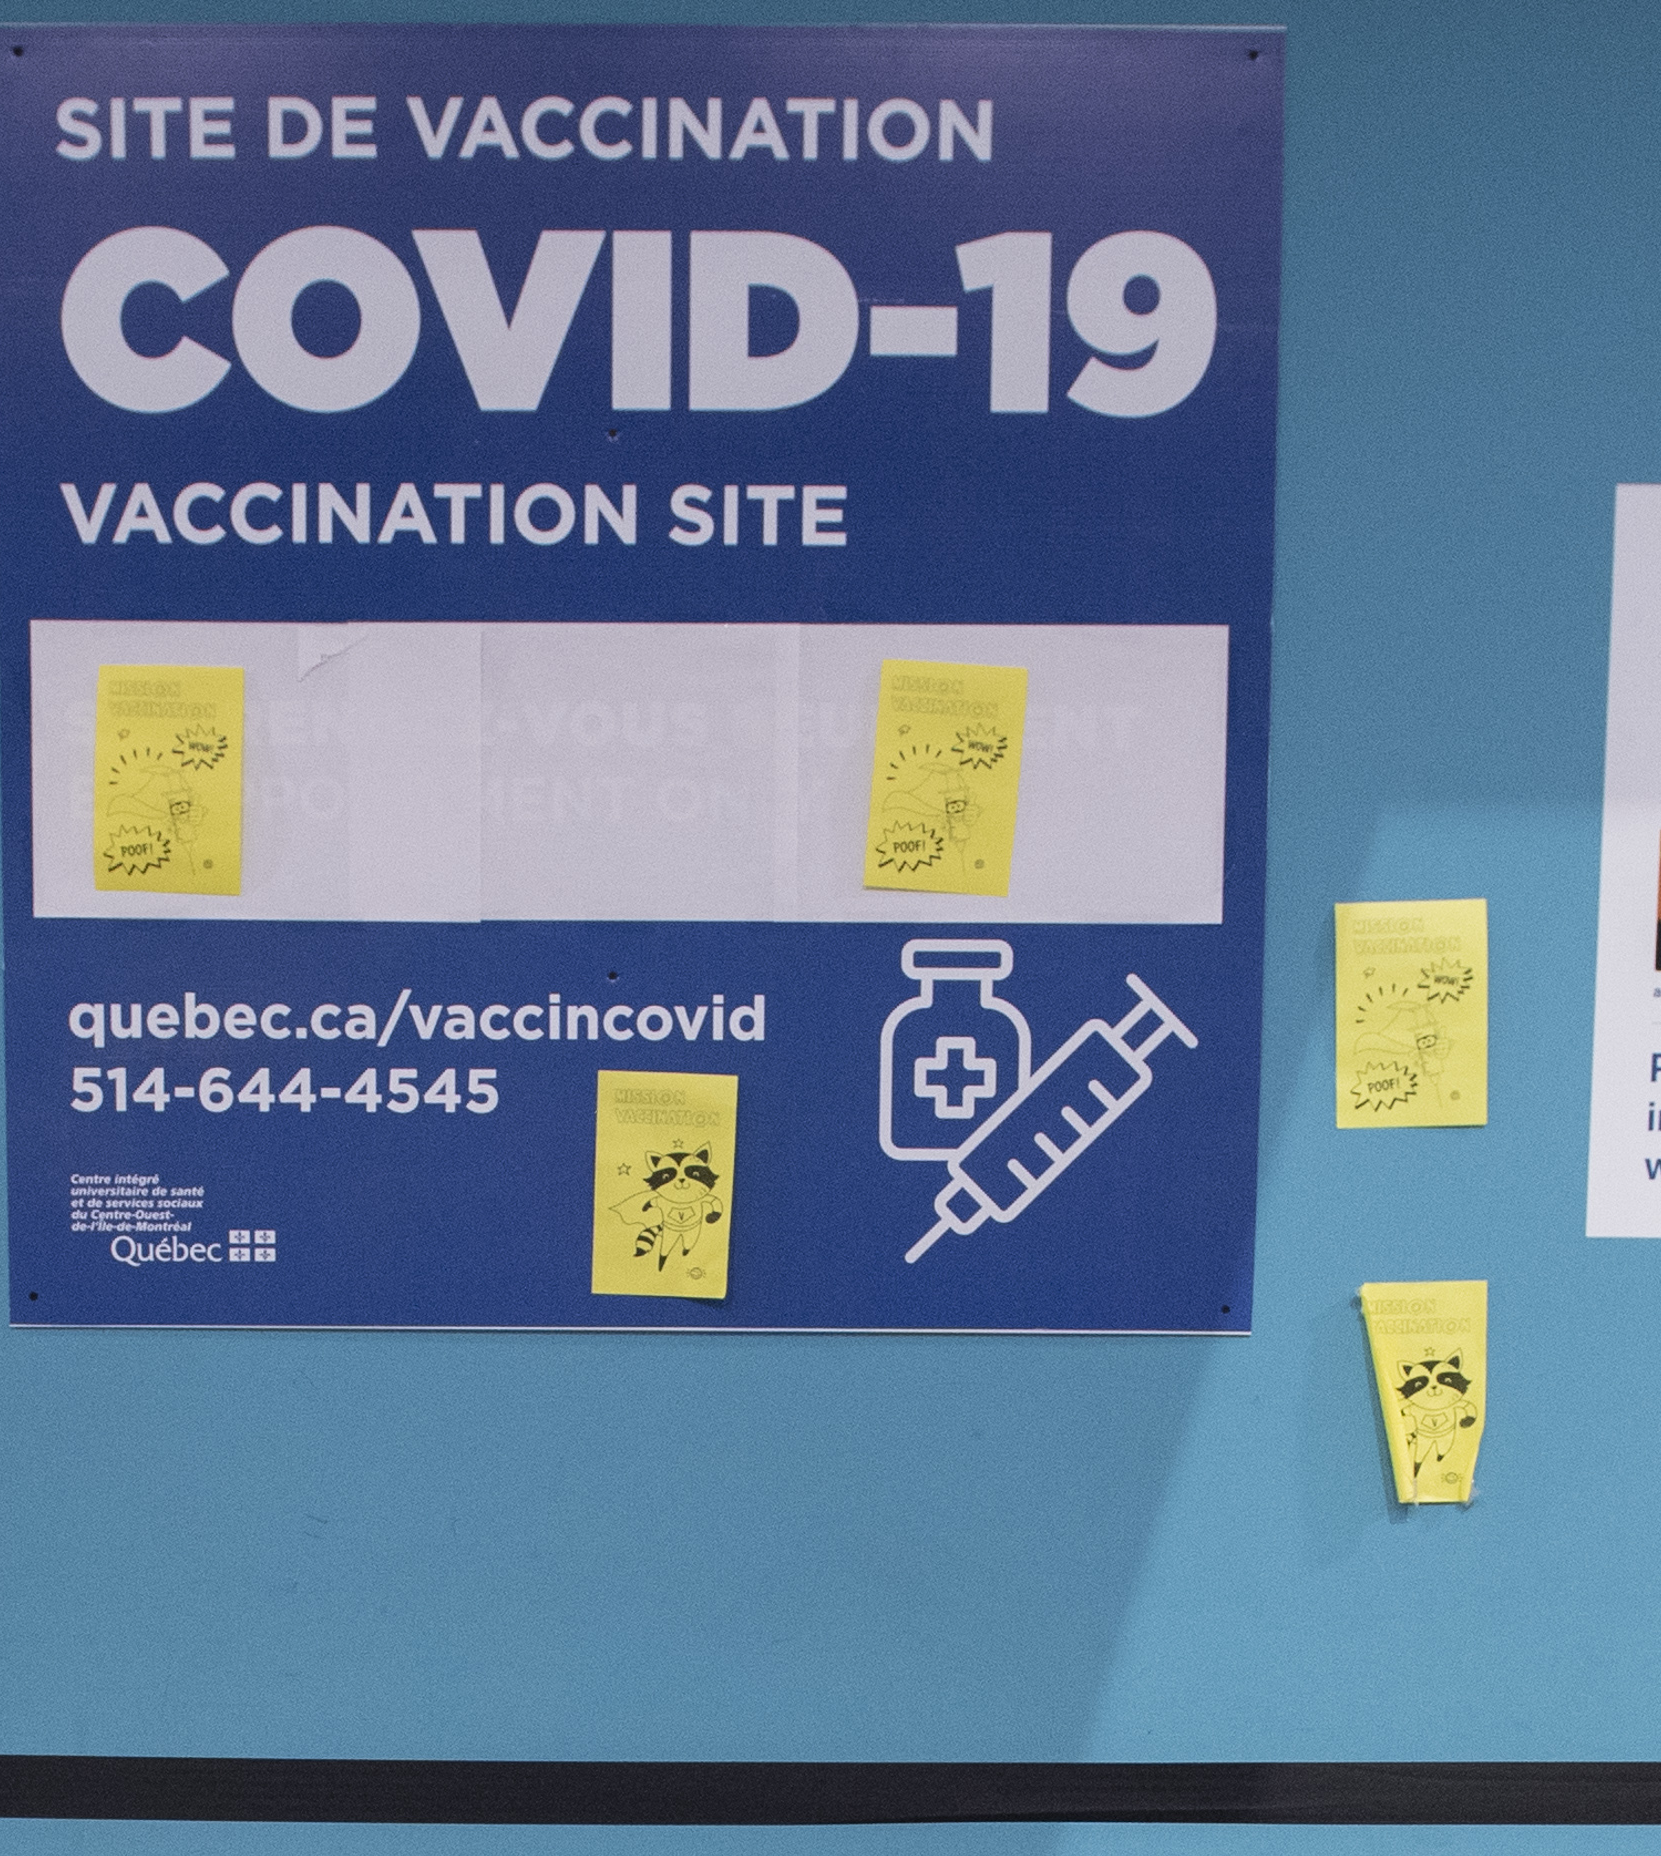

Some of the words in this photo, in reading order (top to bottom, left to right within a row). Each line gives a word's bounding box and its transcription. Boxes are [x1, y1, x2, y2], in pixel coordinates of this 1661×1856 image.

[56, 95, 236, 161] SITE
[268, 95, 380, 161] DE
[407, 95, 994, 163] VACCINATION
[59, 224, 1219, 419] COVID-19
[60, 482, 638, 546] VACCINATION
[668, 485, 848, 547] SITE
[968, 740, 994, 753] WOW!
[121, 843, 153, 857] POOF!
[893, 841, 926, 853] POOF!
[68, 992, 767, 1047] quebec.ca/vaccincovid
[69, 1066, 500, 1116] 514-644-4545
[1367, 1078, 1400, 1093] POOF!
[614, 1088, 685, 1105] MISSION
[614, 1109, 721, 1127] VACCINATION
[70, 1174, 111, 1184] Centre
[115, 1173, 159, 1187] intégré
[71, 1186, 148, 1196] universitaire
[152, 1186, 167, 1196] de
[170, 1186, 205, 1196] santé
[71, 1198, 84, 1208] et
[87, 1198, 103, 1208] de
[106, 1198, 154, 1208] services
[157, 1198, 203, 1208] sociaux
[71, 1210, 87, 1219] du
[91, 1210, 174, 1221] Centre-Ouest-
[110, 1235, 222, 1266] Québec
